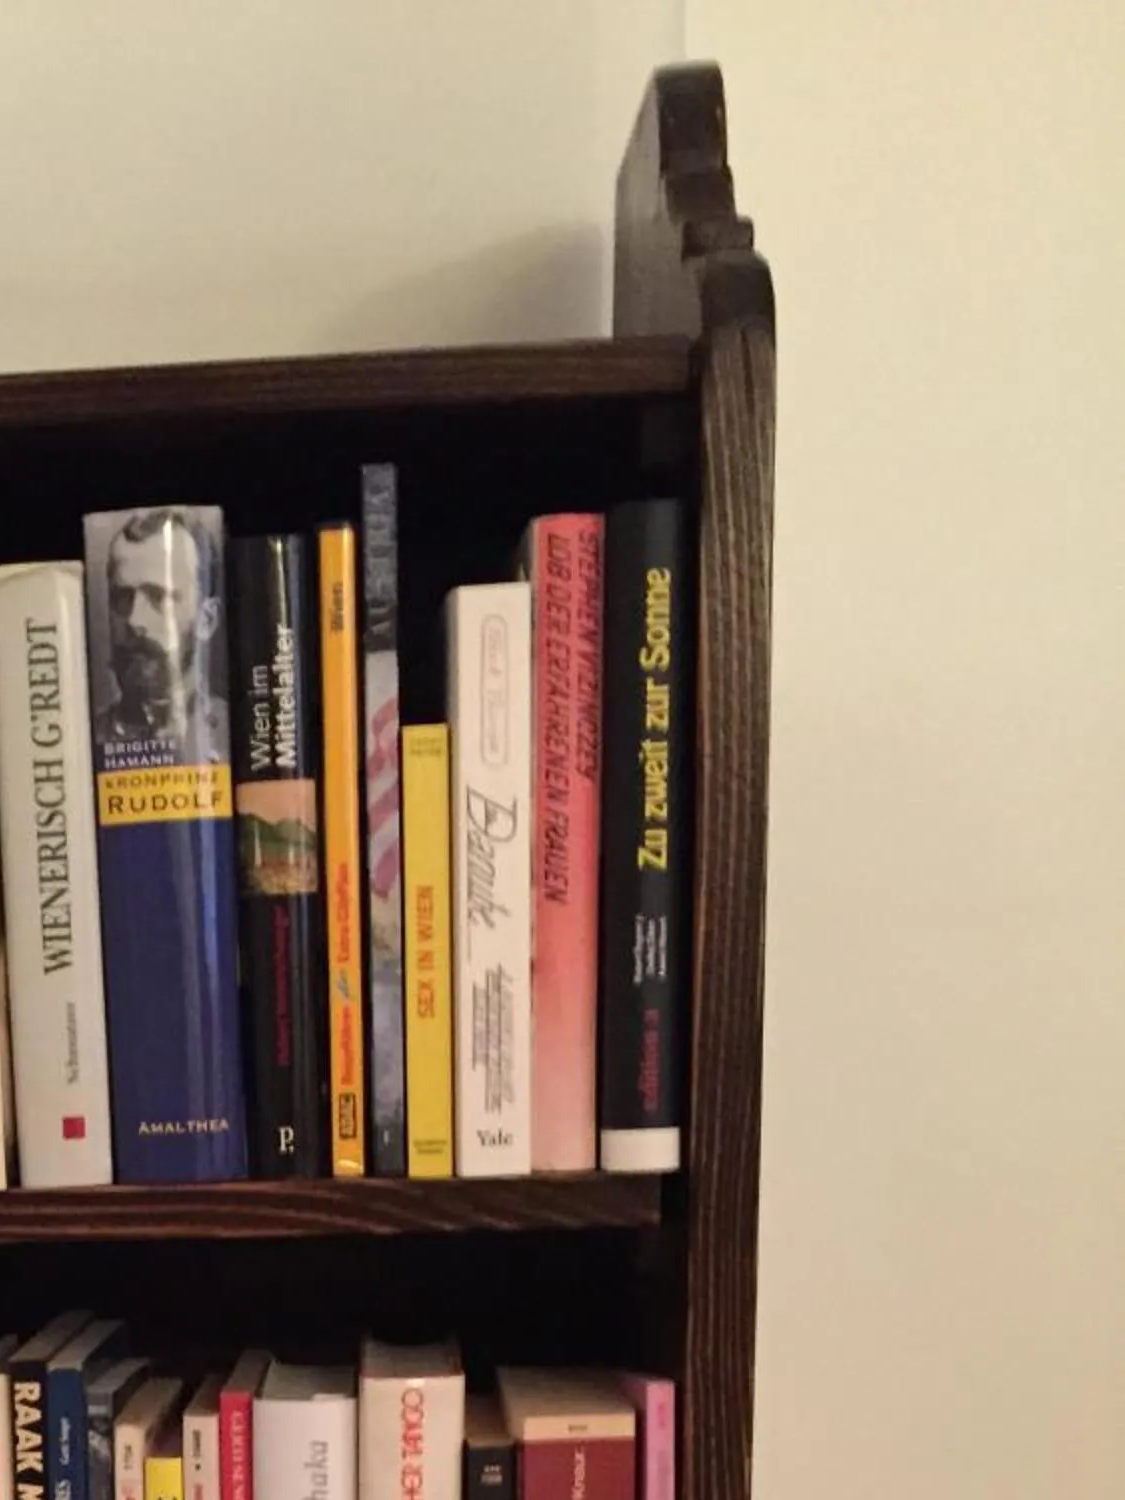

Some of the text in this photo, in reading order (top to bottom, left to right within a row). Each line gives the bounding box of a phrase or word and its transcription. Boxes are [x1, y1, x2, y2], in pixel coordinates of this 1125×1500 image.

[248, 664, 272, 771] Wien im
[271, 623, 298, 769] Mittelalter
[637, 566, 672, 871] Zu zweit zur Sonne
[104, 739, 176, 756] BRIGITTE
[104, 753, 174, 769] HAMANN
[24, 617, 77, 977] WIENERISCH G'REDT
[108, 790, 222, 815] RUDOLF
[543, 805, 569, 906] FRAUEN
[415, 884, 436, 1019] SEX IN WIEN
[138, 1118, 230, 1135] AMALTHEA
[476, 1129, 514, 1149] Yale
[13, 1382, 44, 1473] RAAK
